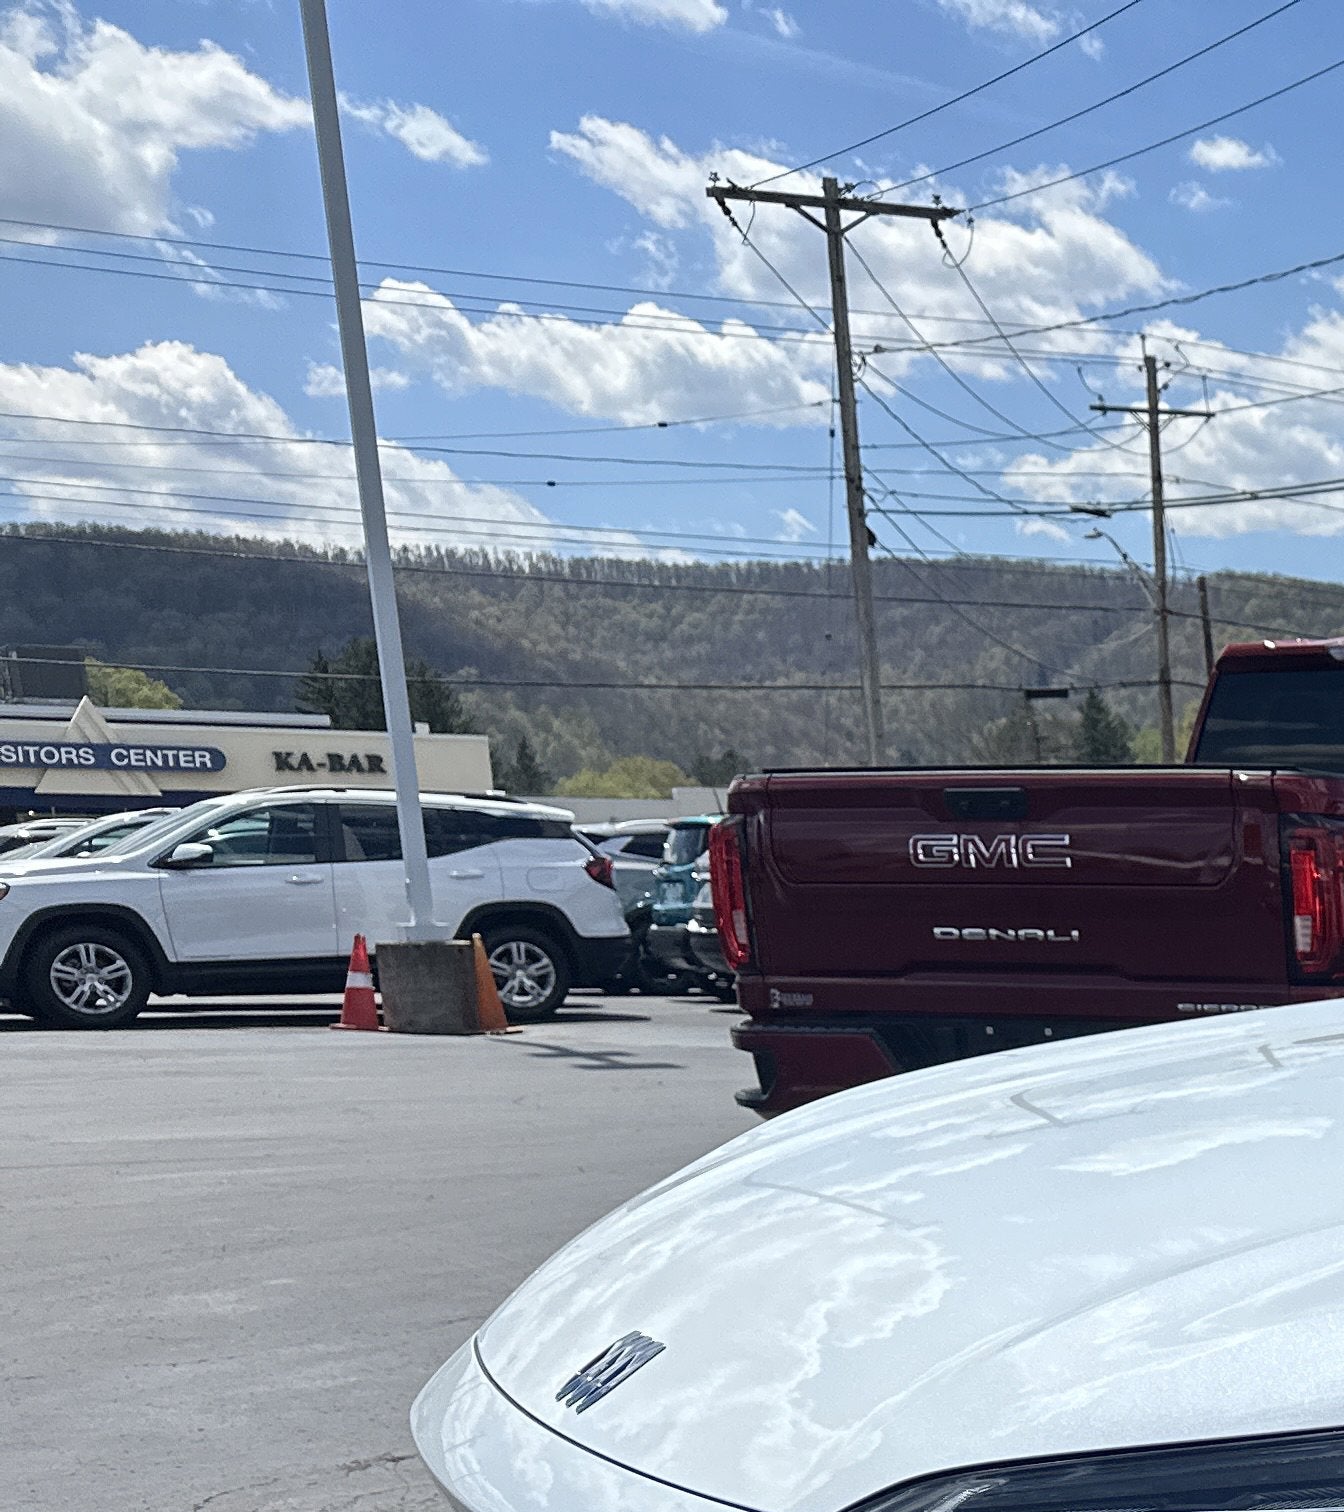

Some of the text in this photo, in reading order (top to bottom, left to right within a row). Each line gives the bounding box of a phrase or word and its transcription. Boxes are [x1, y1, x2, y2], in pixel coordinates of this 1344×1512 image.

[0, 744, 213, 769] SITORS CENTER
[271, 751, 387, 774] KA-BAR
[909, 834, 1072, 869] GMC
[933, 927, 1080, 942] DENALI
[1177, 1003, 1277, 1013] SIERR
